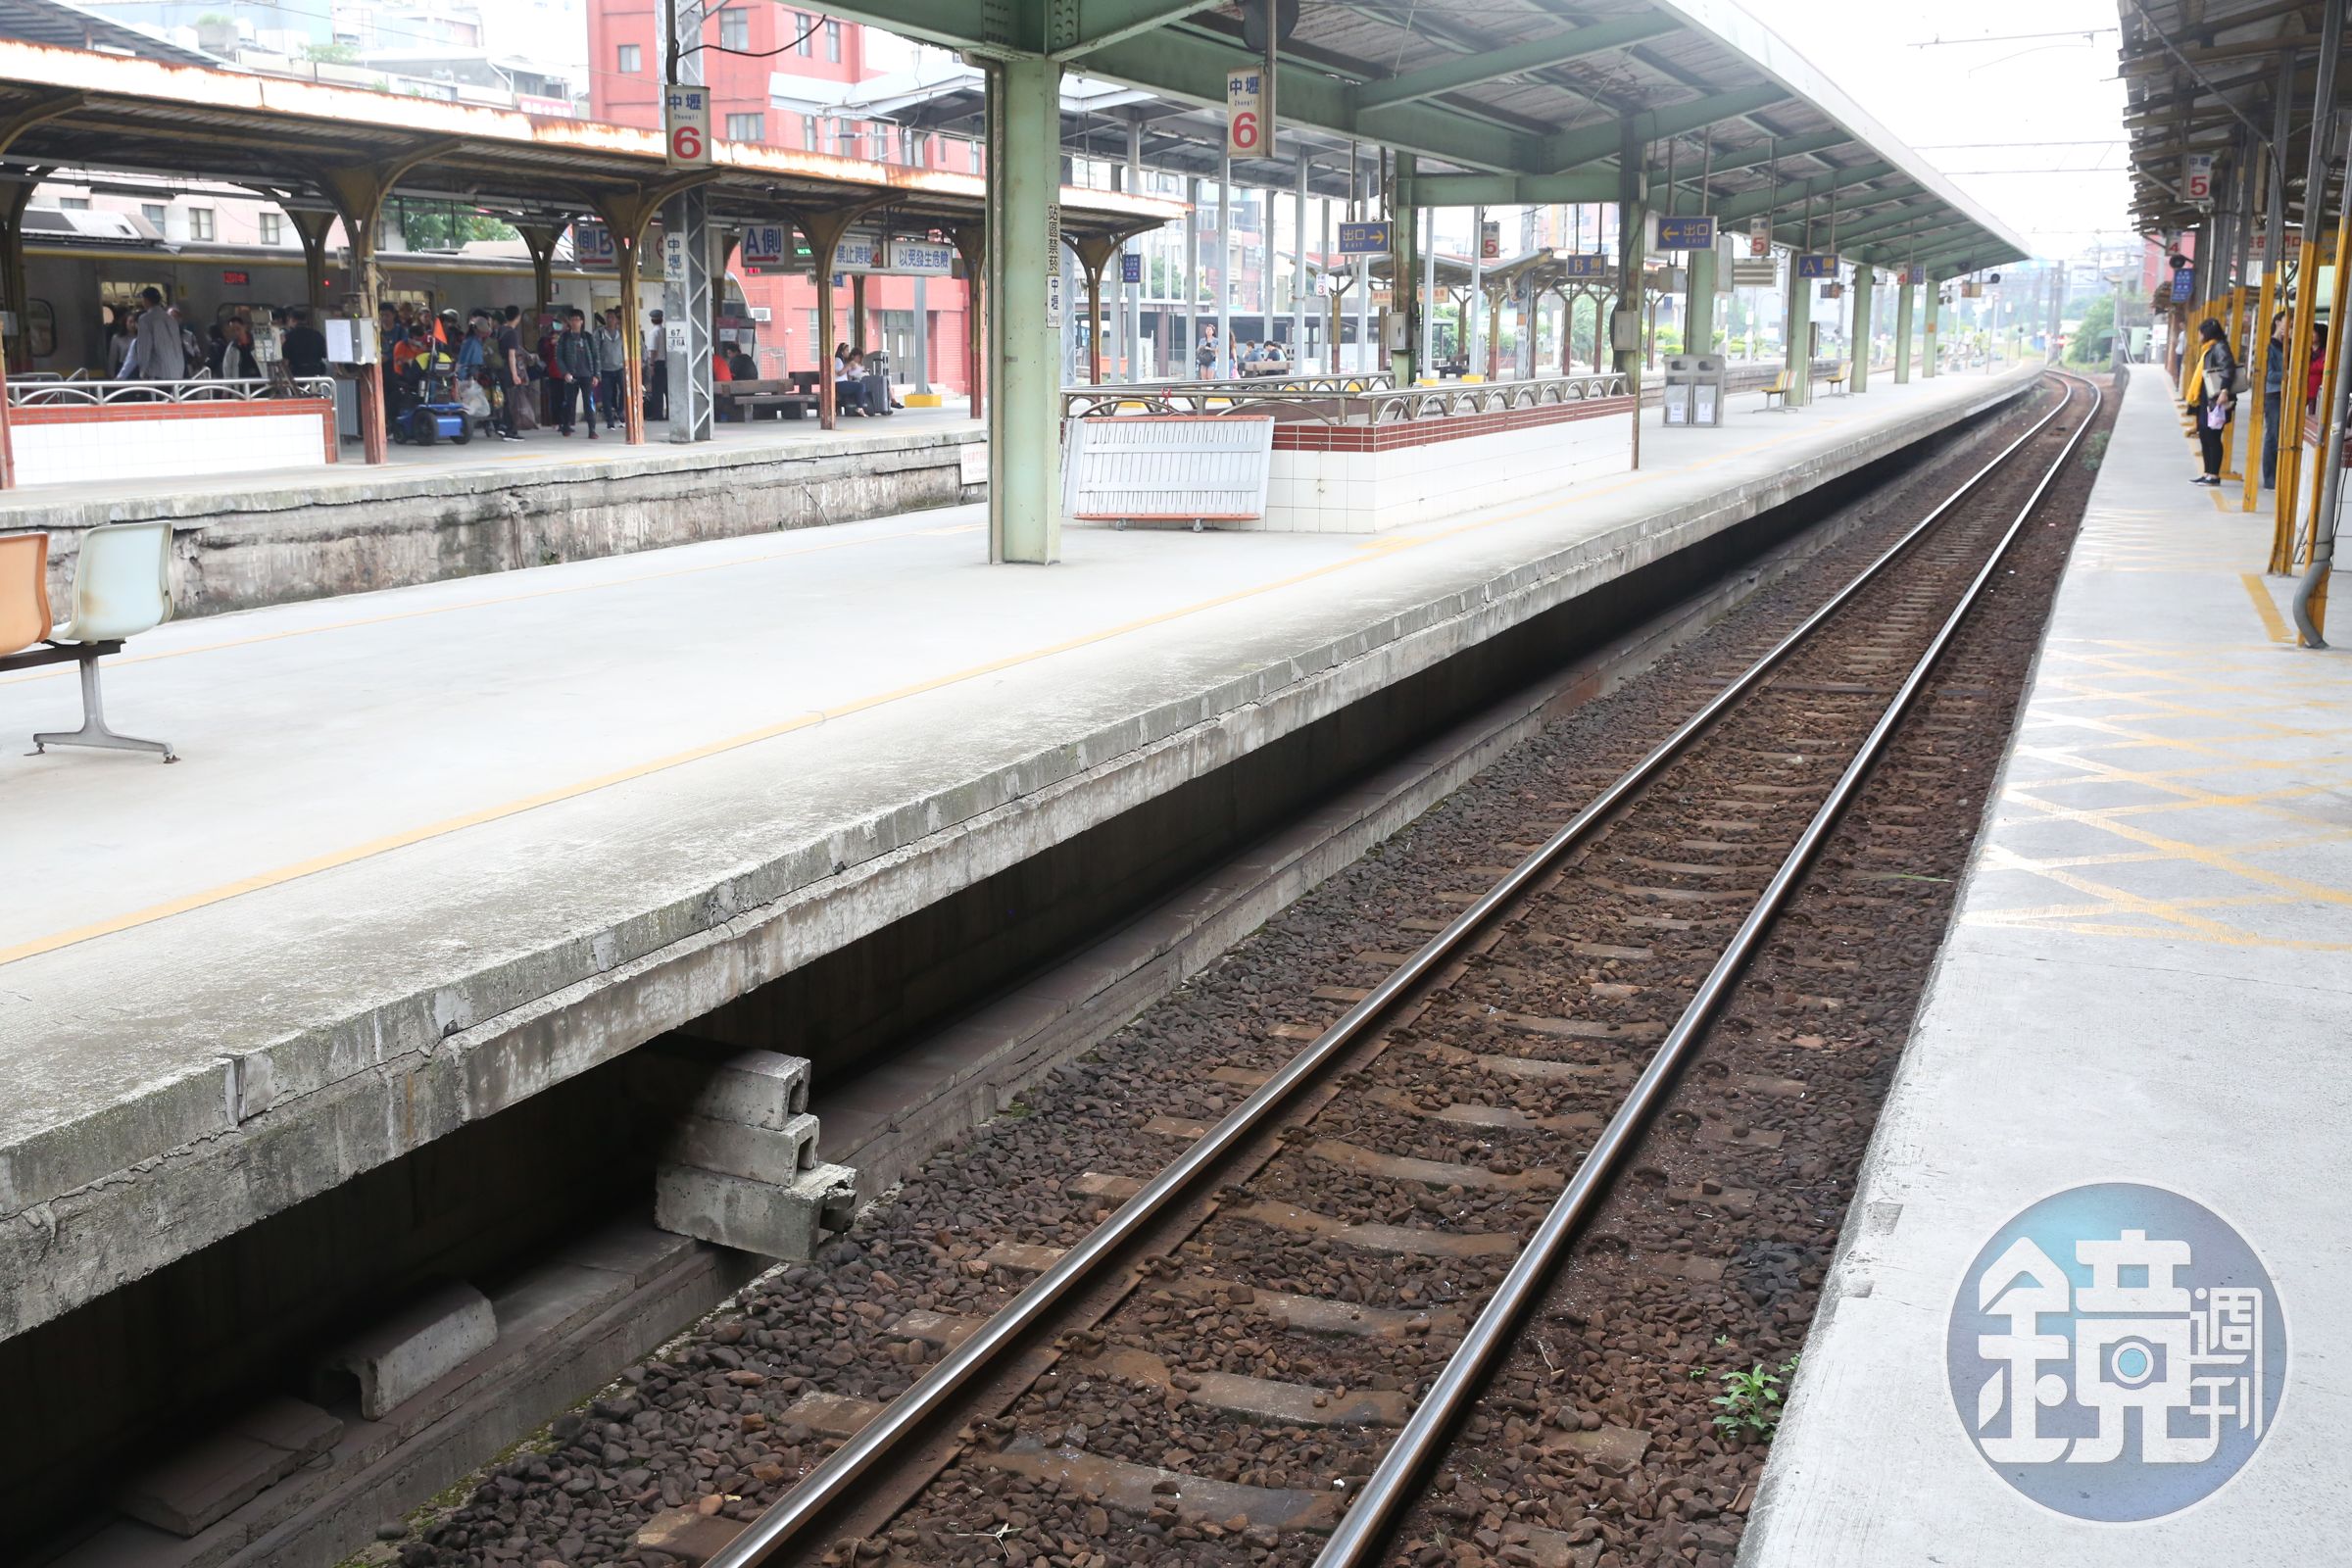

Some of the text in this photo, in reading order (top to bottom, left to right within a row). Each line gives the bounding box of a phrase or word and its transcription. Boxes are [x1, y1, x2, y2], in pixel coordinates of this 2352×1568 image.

[1230, 76, 1259, 95] 中壢
[667, 94, 701, 110] 中壢
[1233, 112, 1258, 148] 6
[673, 126, 702, 160] 6
[2190, 175, 2208, 196] 5
[1343, 229, 1365, 241] 出口
[1684, 223, 1709, 236] 出口
[1485, 239, 1496, 254] 5
[1752, 236, 1764, 252] 5
[2169, 242, 2180, 252] 4
[872, 252, 880, 266] 4
[899, 248, 949, 268] 以免發生危險
[1575, 259, 1584, 273] B
[1803, 260, 1815, 273] A
